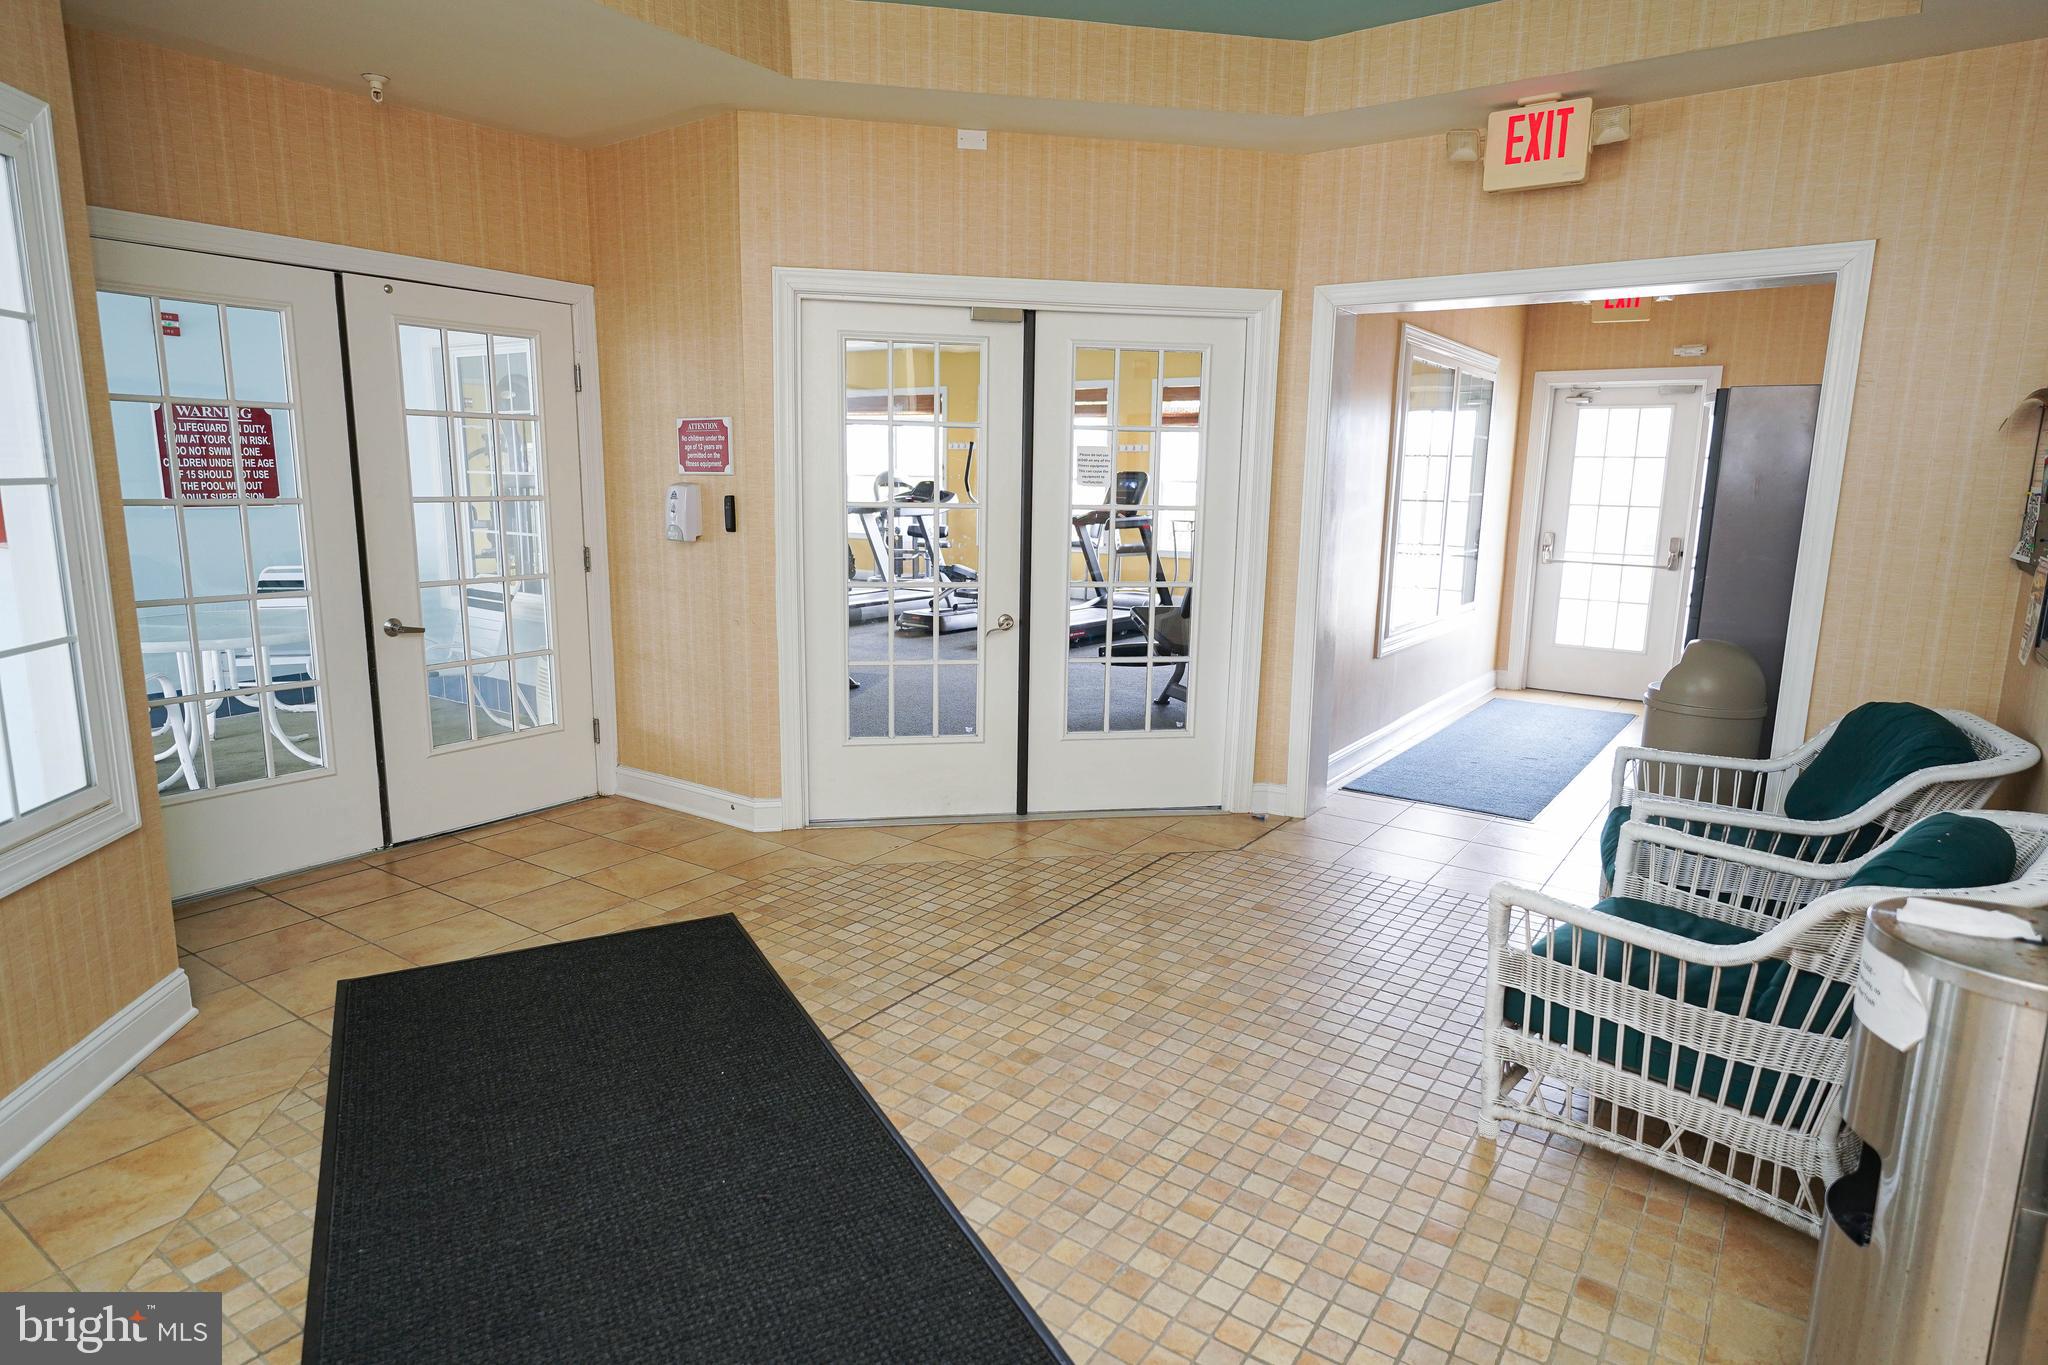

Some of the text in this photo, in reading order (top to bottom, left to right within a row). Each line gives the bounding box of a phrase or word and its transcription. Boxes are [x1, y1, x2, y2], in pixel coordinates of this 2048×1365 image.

[1505, 107, 1574, 165] EXIT
[179, 422, 228, 432] LIFEGUARD
[243, 424, 267, 433] DUTY.
[688, 422, 718, 430] ATTENTION
[190, 435, 200, 443] AT
[201, 435, 226, 444] YOUR
[249, 436, 271, 445] RISK.
[188, 447, 206, 455] NOT
[208, 447, 231, 456] SWIM
[163, 458, 207, 467] CLDREN
[257, 459, 275, 468] AGE
[186, 470, 197, 479] 15
[198, 470, 232, 478] SHOULD
[253, 470, 270, 479] USE
[181, 482, 263, 490] THE POOL WIOUT
